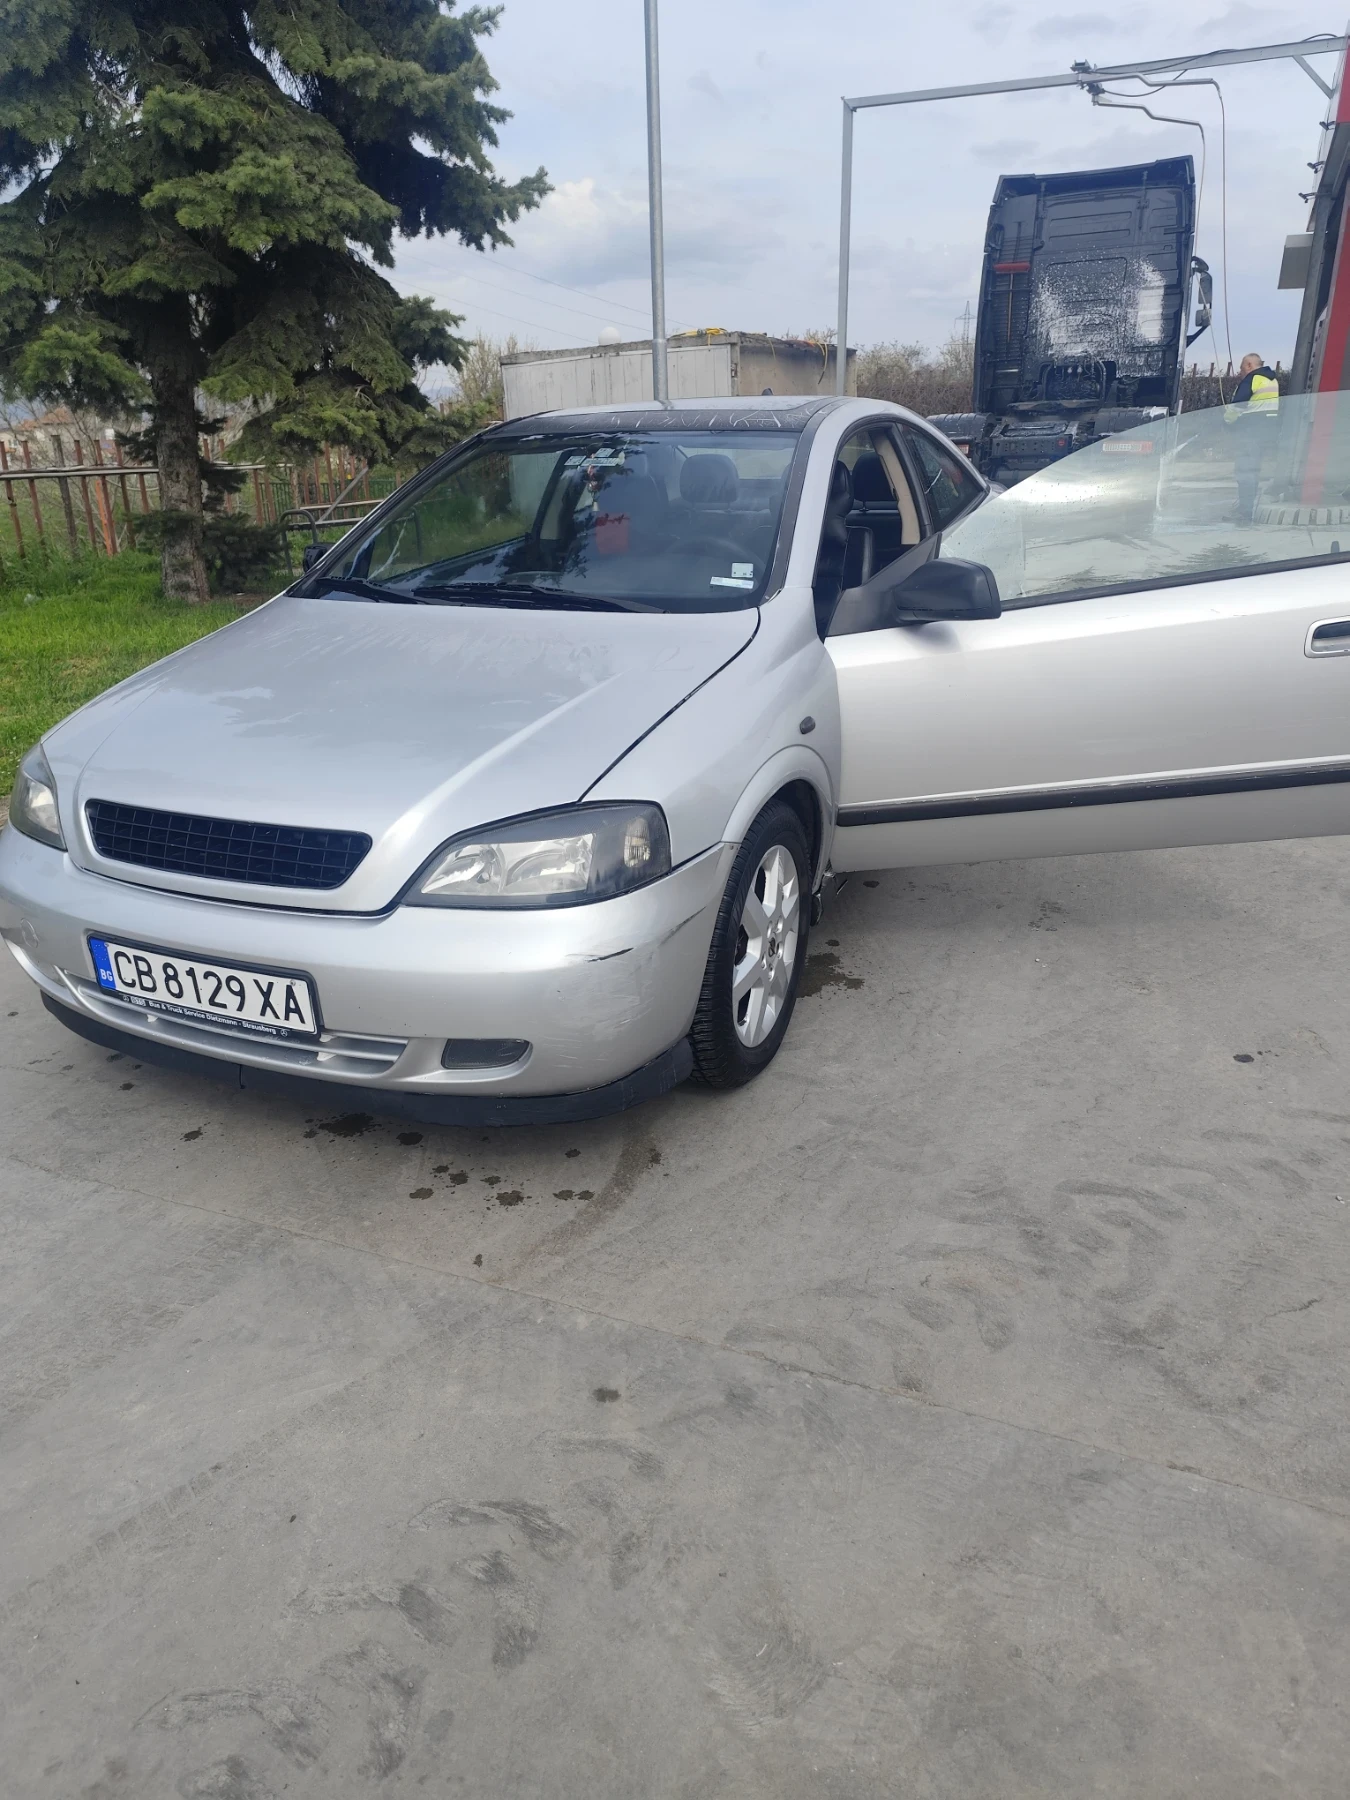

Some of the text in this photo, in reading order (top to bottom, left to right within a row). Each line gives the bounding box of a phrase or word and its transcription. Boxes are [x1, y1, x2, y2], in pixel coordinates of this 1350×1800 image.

[100, 968, 114, 982] BG
[162, 962, 246, 1012] 8129
[148, 1000, 161, 1009] Bus
[166, 1003, 183, 1014] Truck
[183, 1009, 206, 1019] Service
[242, 1021, 277, 1035] Strausberg
